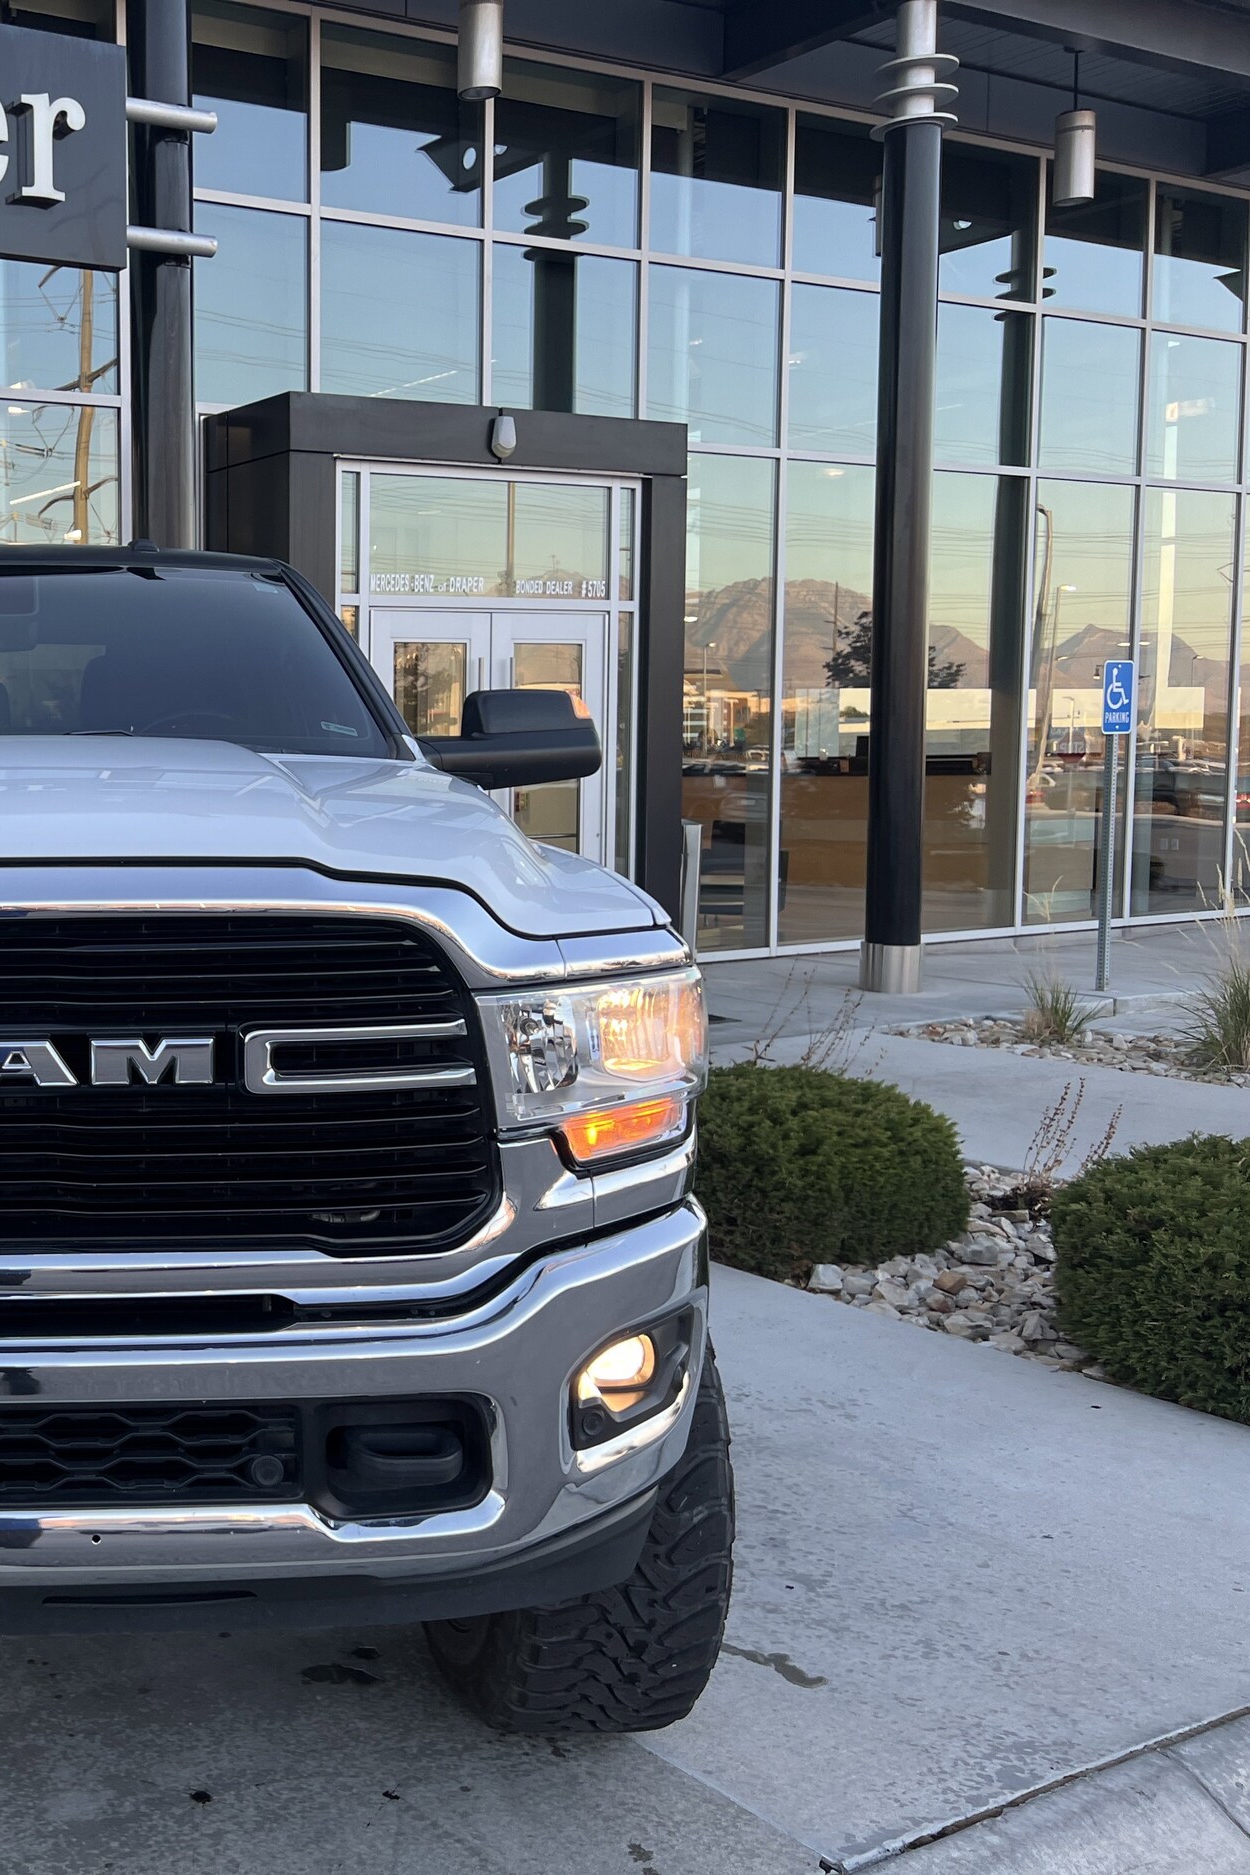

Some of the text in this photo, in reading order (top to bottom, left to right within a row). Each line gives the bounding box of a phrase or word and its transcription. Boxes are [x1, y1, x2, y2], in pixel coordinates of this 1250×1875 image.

[438, 581, 448, 592] of
[449, 577, 484, 592] DRAPER
[515, 580, 543, 594] BONDED
[546, 581, 573, 595] DEALER
[1105, 712, 1129, 723] PARKING
